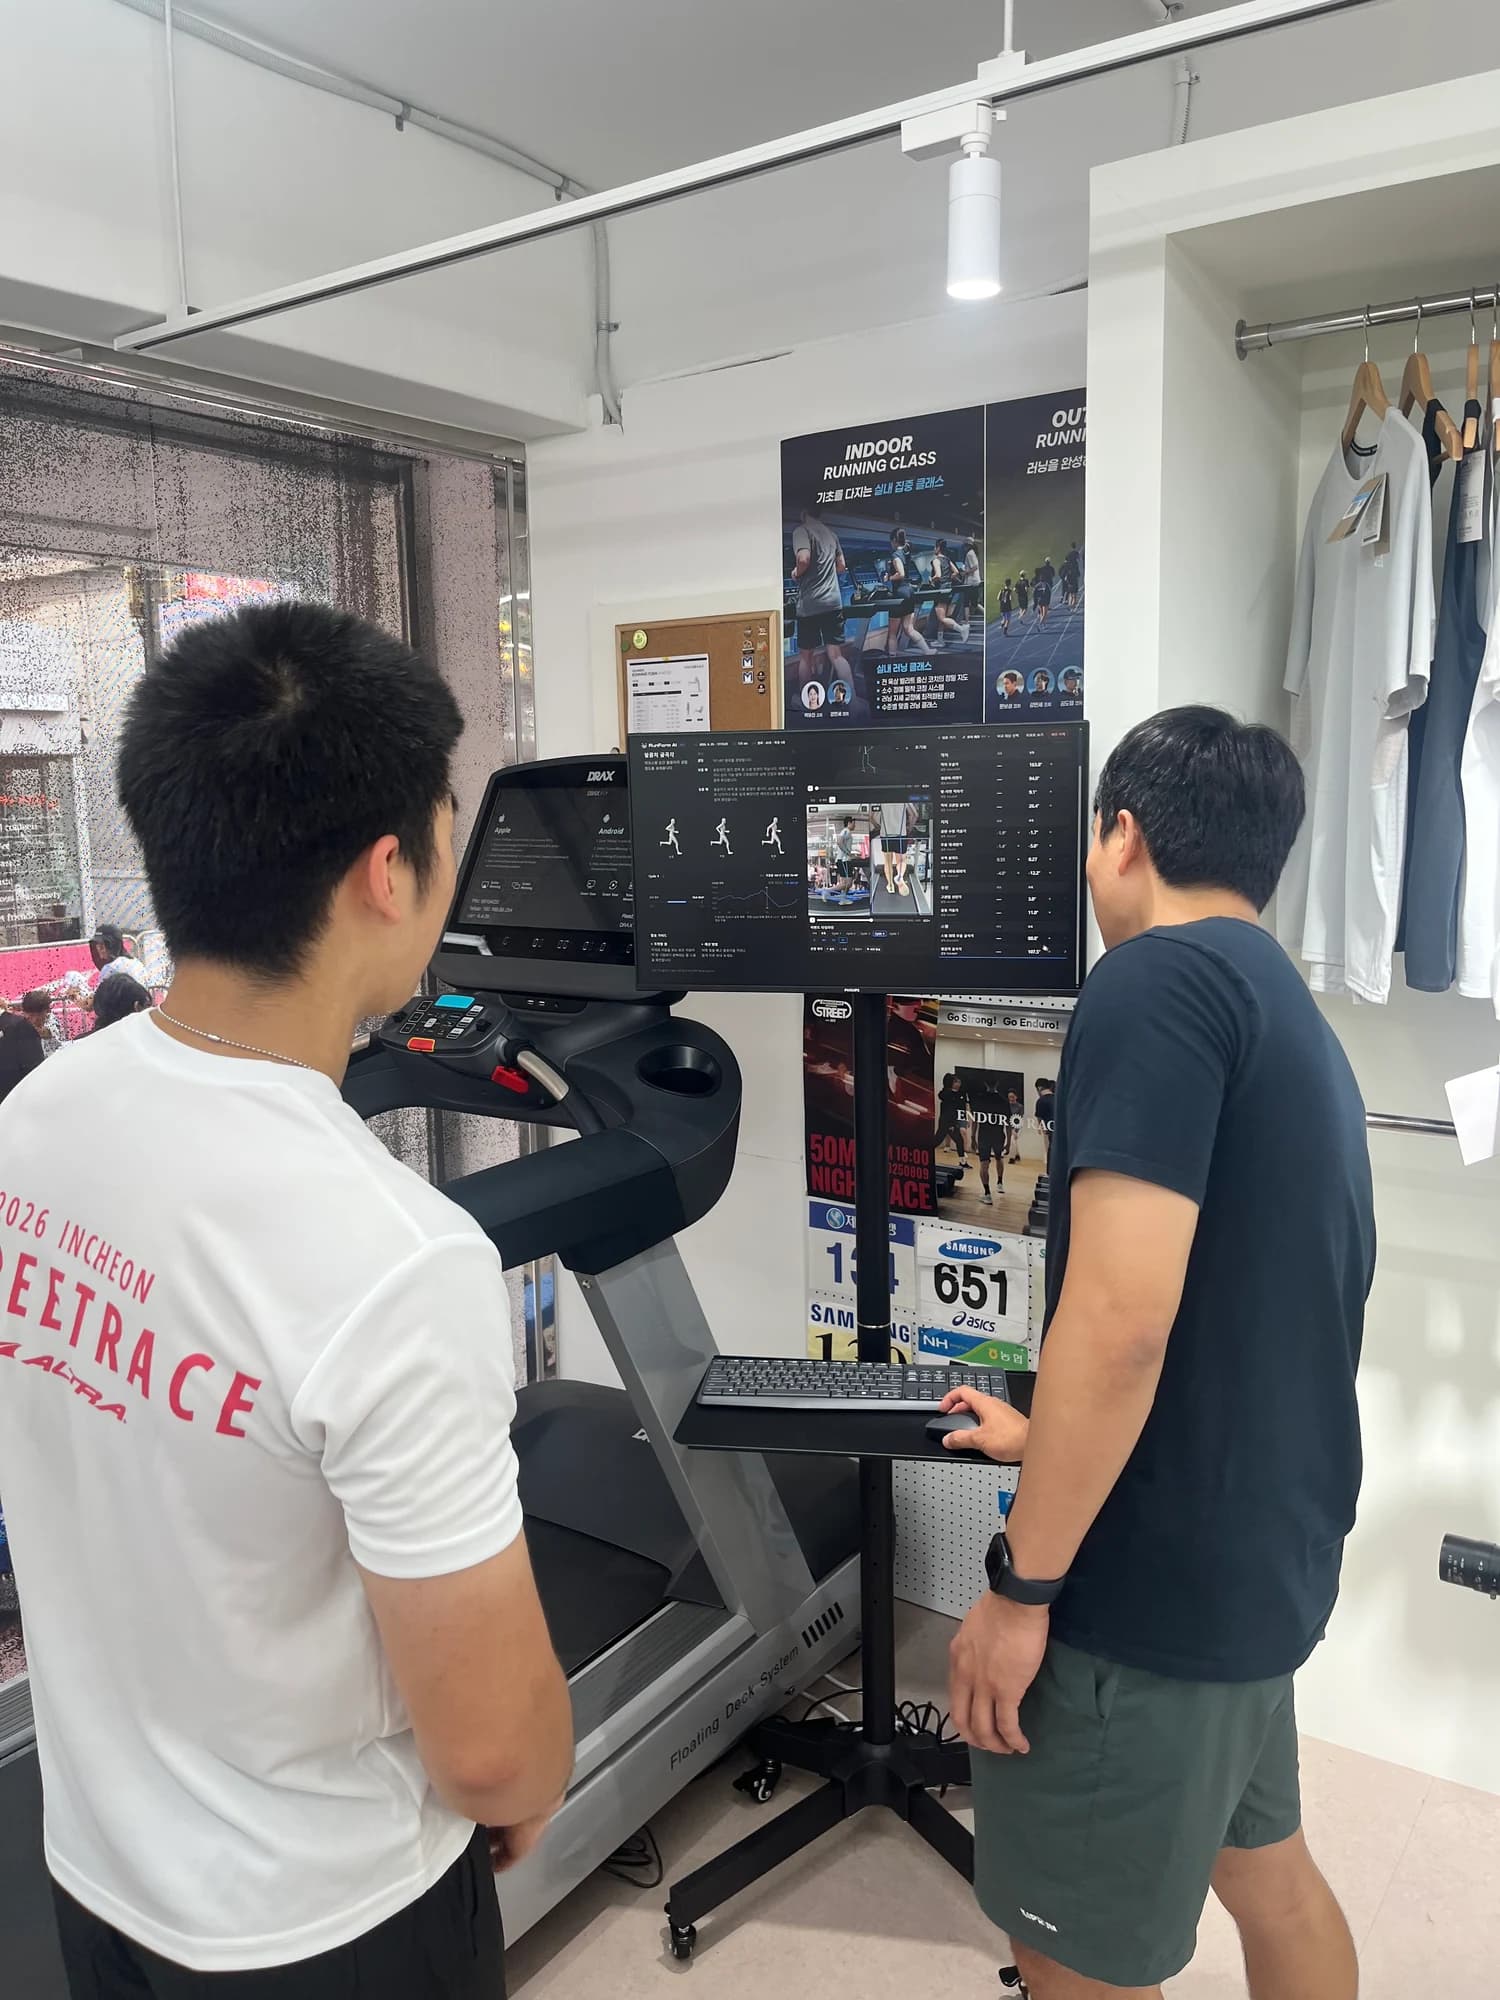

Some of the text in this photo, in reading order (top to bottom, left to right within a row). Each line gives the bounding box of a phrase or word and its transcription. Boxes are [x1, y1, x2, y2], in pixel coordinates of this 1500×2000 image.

[845, 436, 913, 461] INDOOR
[823, 451, 937, 480] RUNNING CLASS
[1026, 458, 1059, 474] 러닝을
[816, 475, 944, 503] 기초를 다지는 실내 집중 클래스
[877, 661, 932, 674] 실내 러닝 클래스
[957, 673, 968, 681] 지도
[909, 701, 920, 709] 러닝
[921, 701, 937, 709] 클래스
[586, 771, 616, 782] DRAX
[494, 827, 511, 835] Apple
[598, 827, 625, 835] Android
[816, 1006, 848, 1018] STREET
[947, 1013, 1060, 1030] Go Strong! Go Enduro!
[895, 1146, 929, 1166] 18:00
[888, 1162, 929, 1180] 250809
[946, 1241, 995, 1256] SAMSUNG
[58, 1219, 156, 1305] INCHEON
[934, 1263, 1007, 1316] 651
[811, 1303, 910, 1344] SAMNG
[966, 1316, 996, 1332] asics
[0, 1250, 262, 1439] EETRACE
[923, 1334, 948, 1350] NH
[670, 1645, 799, 1771] Floating Deck System
